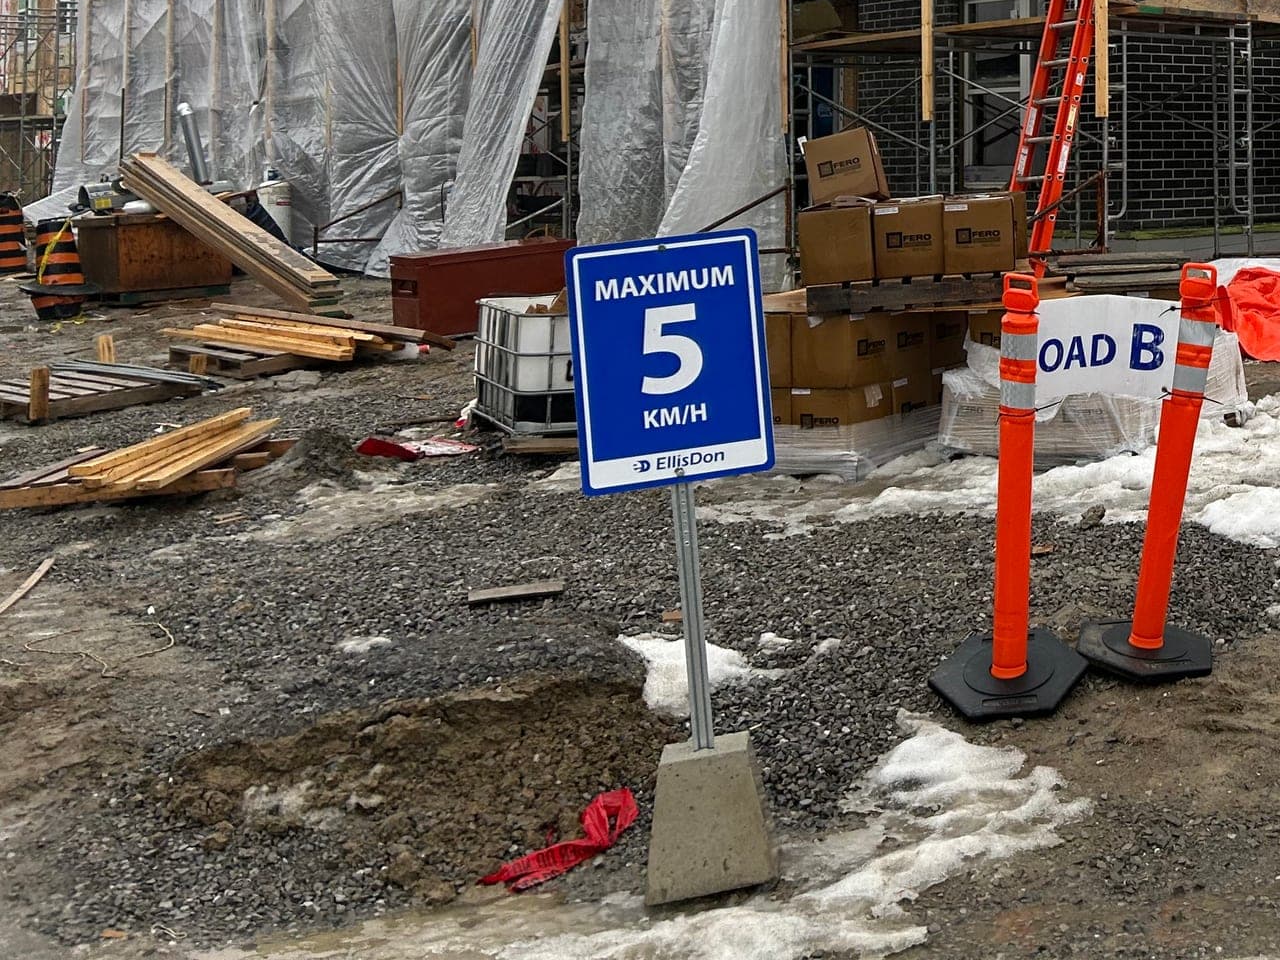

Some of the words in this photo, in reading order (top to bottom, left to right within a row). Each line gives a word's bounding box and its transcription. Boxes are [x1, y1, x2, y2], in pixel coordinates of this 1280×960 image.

[833, 157, 860, 169] FERO
[902, 233, 932, 242] FERO
[971, 230, 1001, 238] FERO
[595, 265, 735, 301] MAXIMUM
[641, 303, 704, 395] 5
[1039, 333, 1117, 373] OAD
[1129, 323, 1165, 371] B
[643, 403, 708, 429] KM/H
[656, 451, 725, 471] EllisDon
